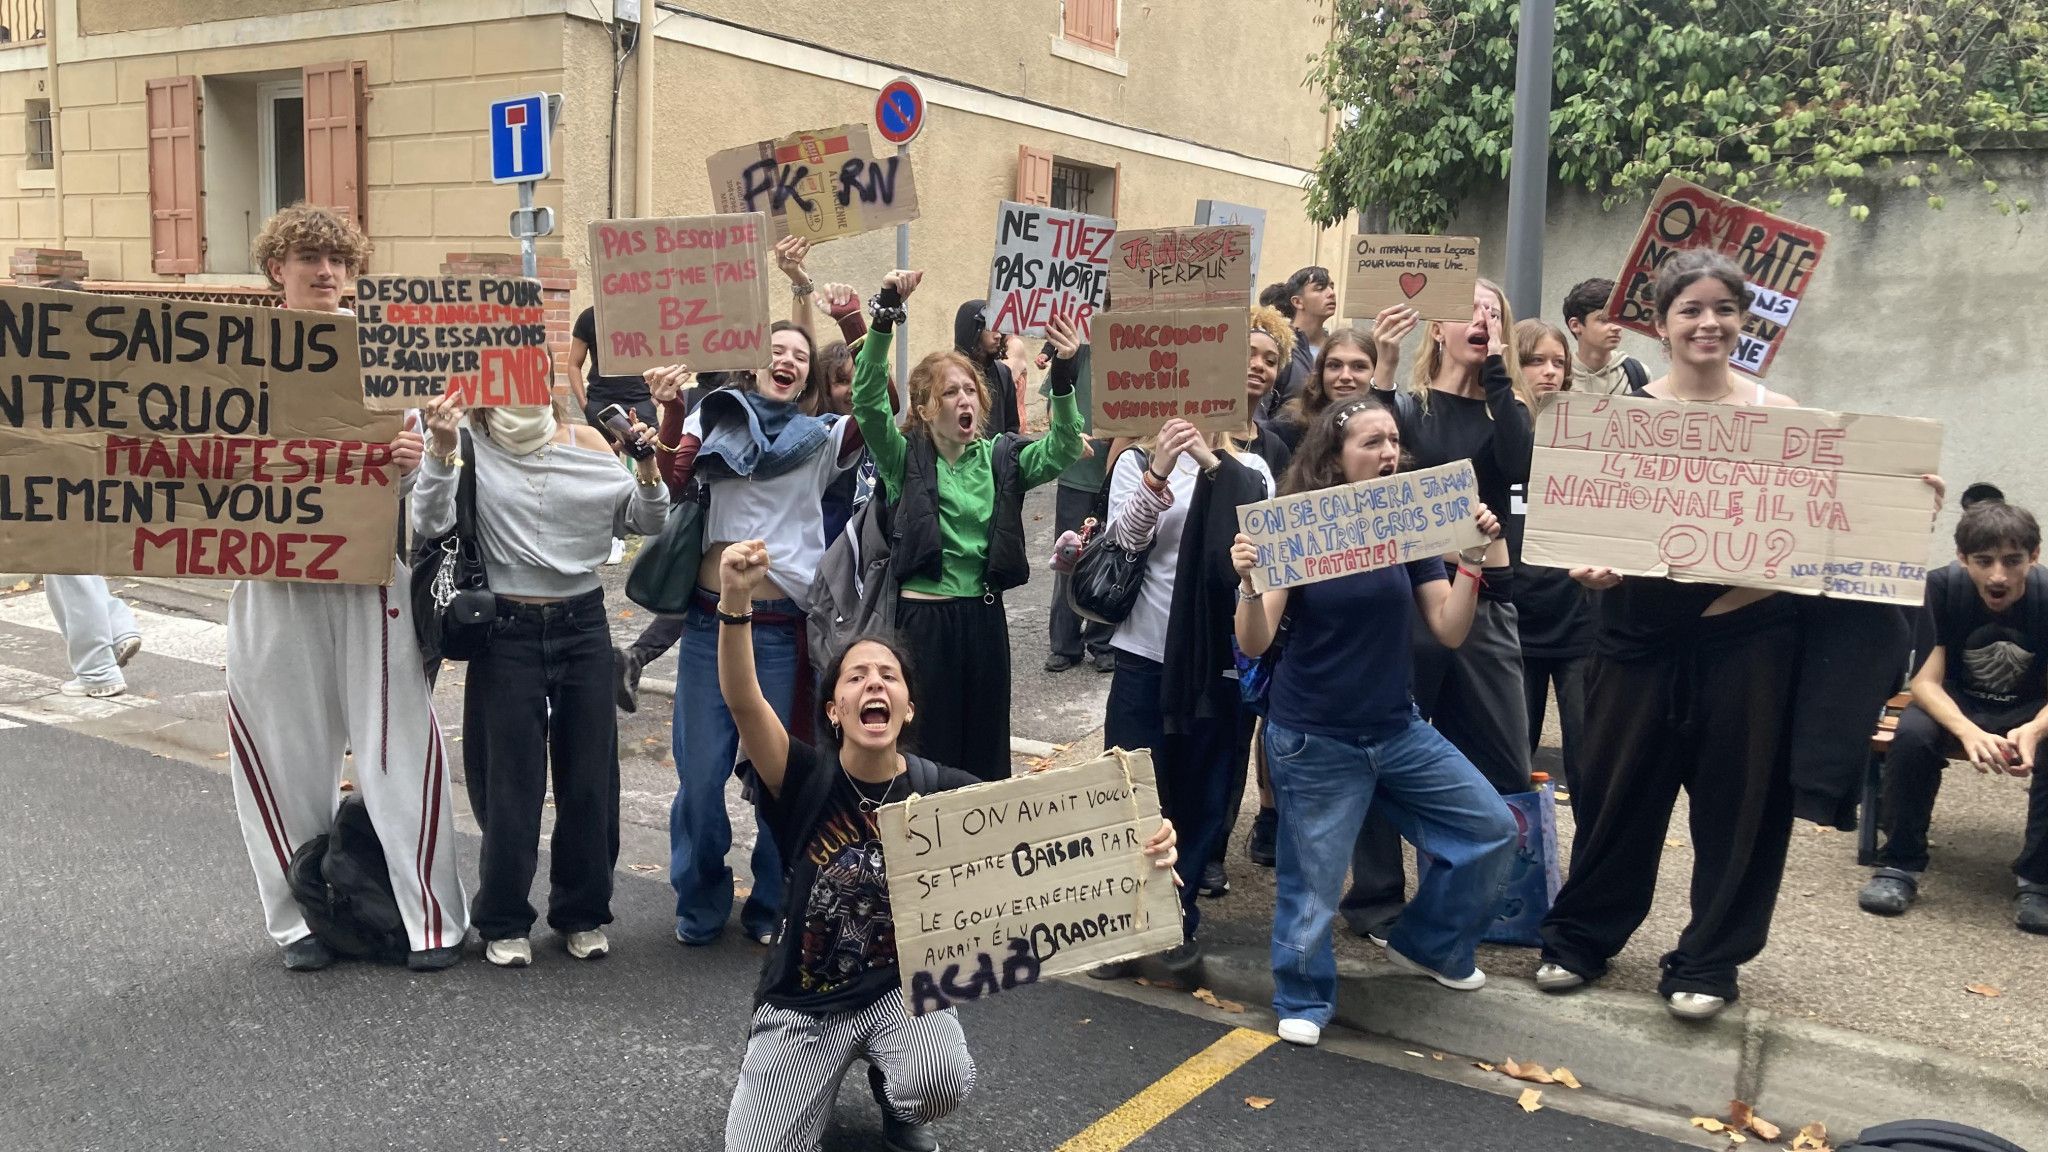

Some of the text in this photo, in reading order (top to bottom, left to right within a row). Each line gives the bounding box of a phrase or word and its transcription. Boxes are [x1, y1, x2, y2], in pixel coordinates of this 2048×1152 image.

[837, 156, 900, 206] RN
[599, 223, 759, 260] PAS BESOIN DE
[1002, 210, 1115, 264] NE TUEZ
[1120, 227, 1250, 269] JEUNESSE
[602, 270, 652, 296] GARS
[712, 258, 757, 287] FAIS
[994, 252, 1108, 308] PAS NOTRE
[1385, 260, 1405, 268] vous
[479, 279, 543, 306] POUR
[658, 296, 725, 331] BZ
[357, 305, 382, 324] LE
[0, 299, 339, 373] NE SAIS PLUS
[358, 324, 546, 349] NOUS ESSAYONS
[610, 330, 654, 358] PAR
[659, 333, 691, 357] LE
[360, 347, 481, 373] DE SAUVER
[364, 345, 551, 406] NOTRE AVENIR
[1107, 367, 1190, 391] DEVENIR
[1149, 350, 1178, 372] OU
[138, 382, 269, 435] QUOI
[1102, 399, 1179, 420] VENDEUR
[1551, 399, 1846, 465] L'ARGENT DE
[106, 434, 392, 487] MANIFESTER
[198, 483, 324, 524] VOUS
[1245, 468, 1474, 536] ON SE CALMERA JAMAIS
[1755, 488, 1794, 522] IL
[1806, 500, 1851, 532] VA
[133, 527, 348, 580] MERDEZ
[1255, 542, 1277, 569] ON
[1278, 532, 1303, 566] EN
[1317, 516, 1372, 551] TROP
[1372, 506, 1429, 540] GROS
[1430, 496, 1472, 527] SUR
[1267, 564, 1303, 588] LA
[908, 807, 943, 857] SI
[962, 803, 1009, 836] ON
[1018, 794, 1078, 823] AVAIT
[917, 873, 941, 899] SE
[950, 853, 1007, 888] FAIRE
[1100, 827, 1140, 852] PAR
[920, 911, 944, 933] LE
[954, 877, 1115, 932] GOUVERNEMENT
[924, 936, 982, 967] AURAIT
